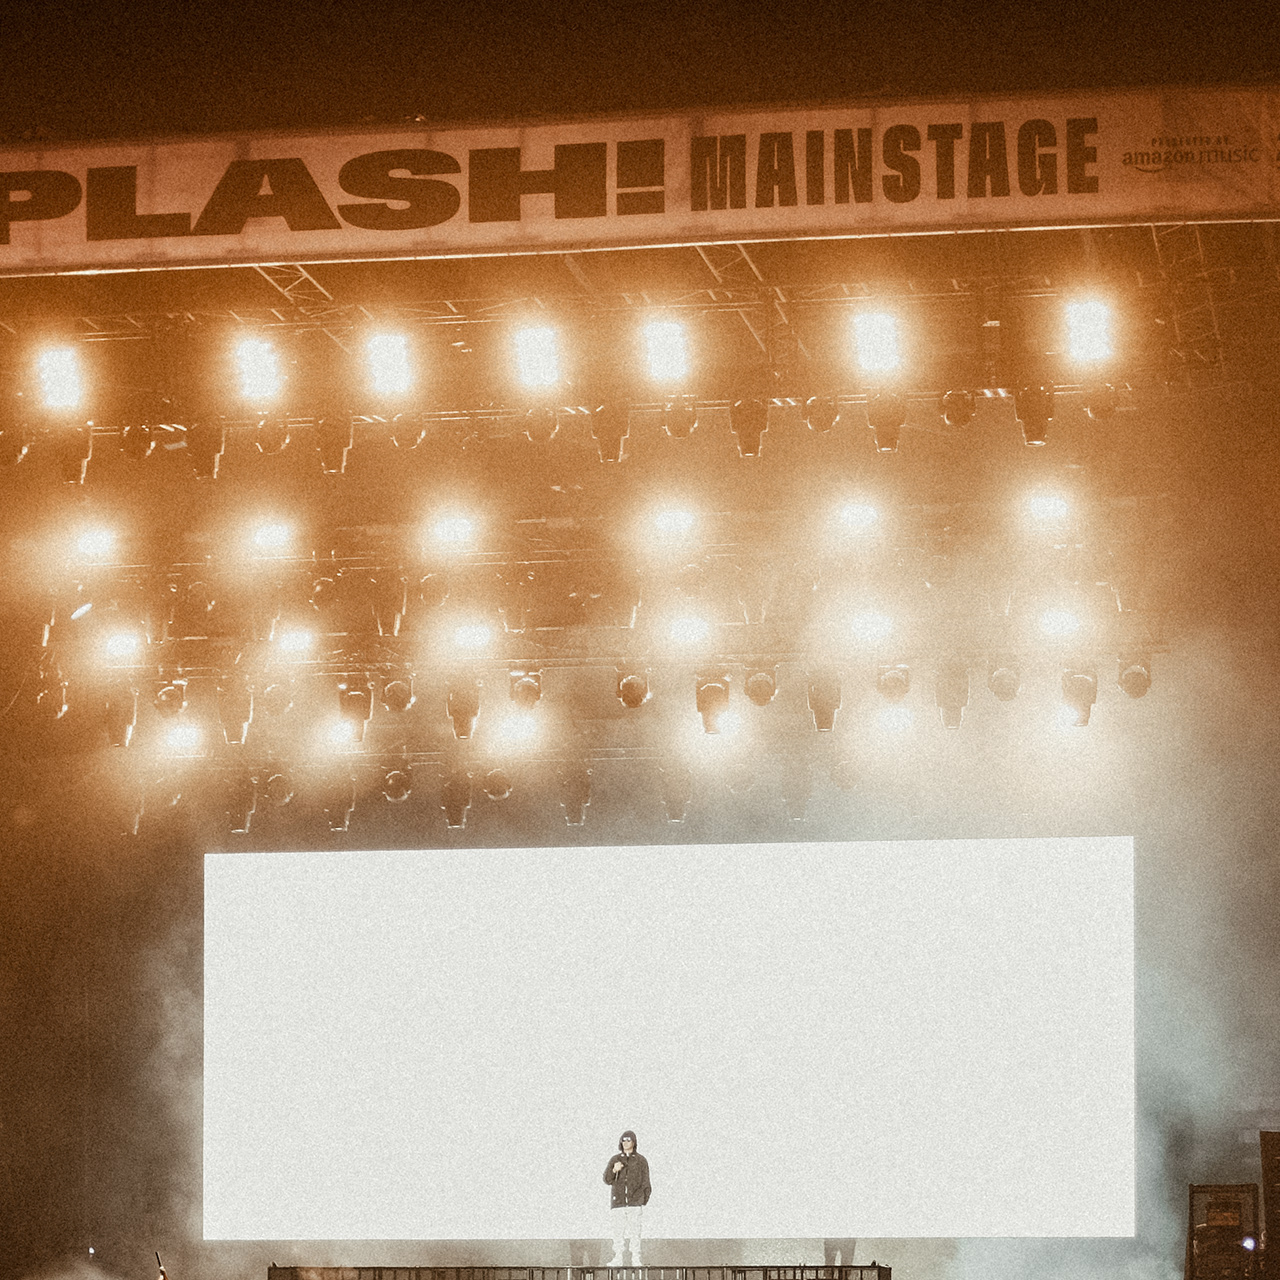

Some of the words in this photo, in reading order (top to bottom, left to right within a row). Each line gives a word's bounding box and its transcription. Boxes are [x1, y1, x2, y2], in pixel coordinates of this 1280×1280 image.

[690, 117, 1098, 212] MAINSTAGE
[1122, 149, 1195, 167] amazon
[1199, 145, 1261, 164] music
